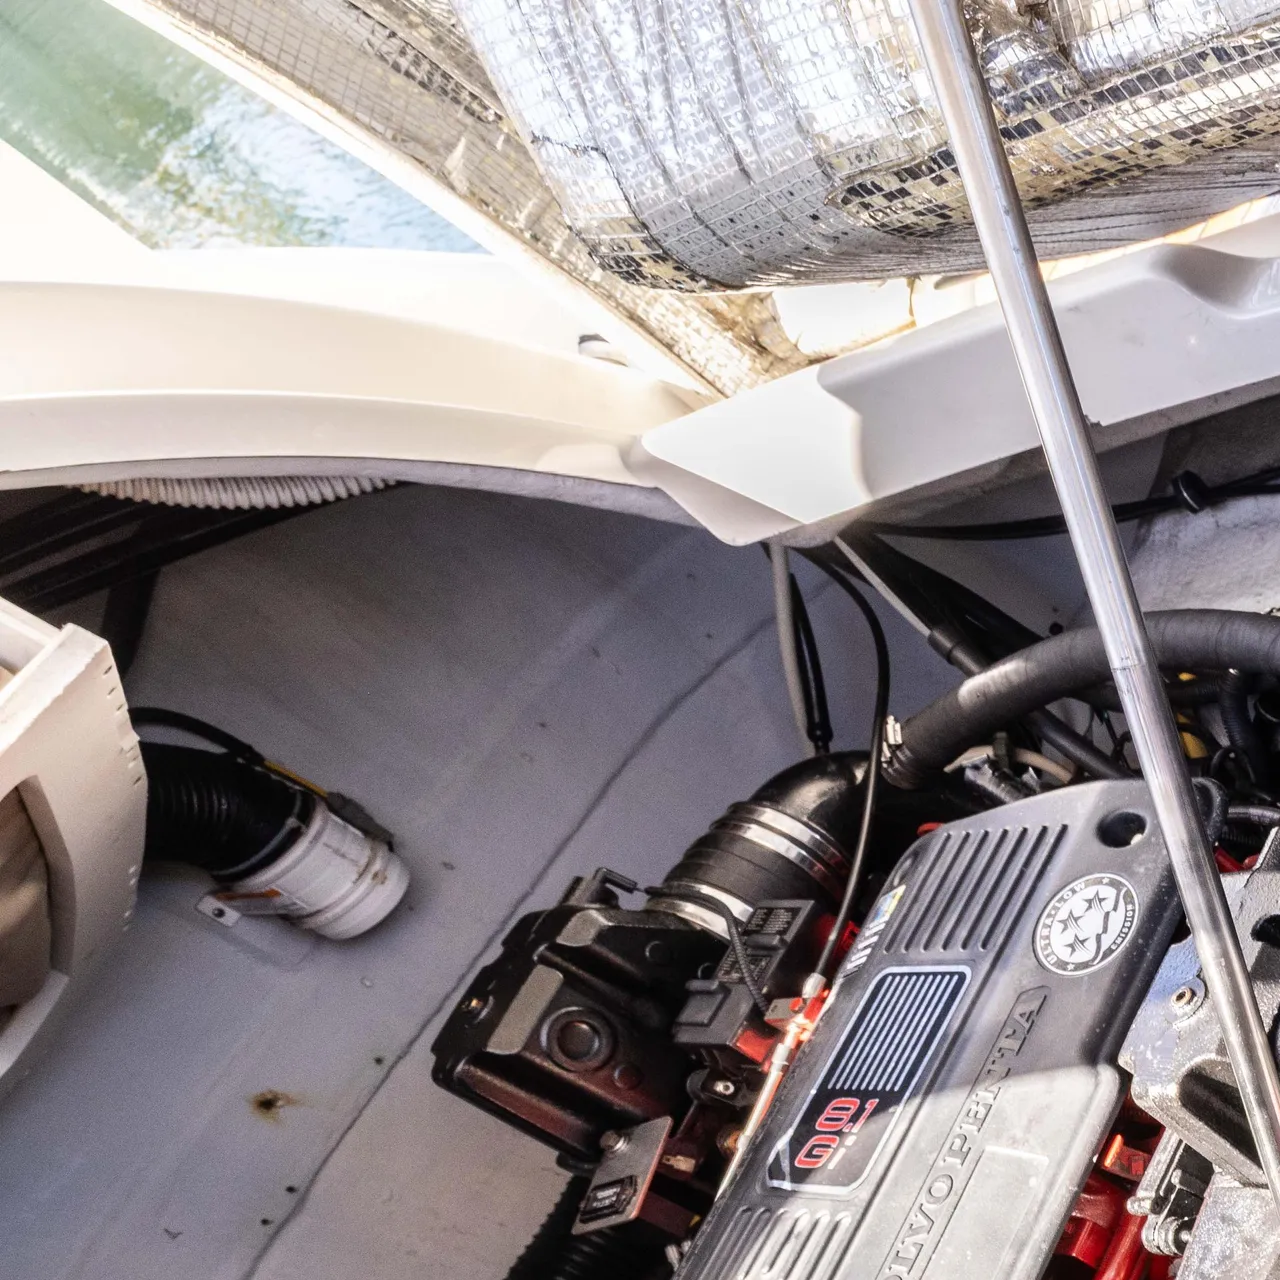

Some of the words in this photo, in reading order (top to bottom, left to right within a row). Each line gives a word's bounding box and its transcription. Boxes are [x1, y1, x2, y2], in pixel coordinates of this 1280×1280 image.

[1054, 882, 1086, 907] LOW
[1111, 904, 1135, 950] EMISSION
[943, 994, 1048, 1168] PENTA
[815, 1097, 879, 1133] 8.1
[794, 1134, 857, 1170] Gi
